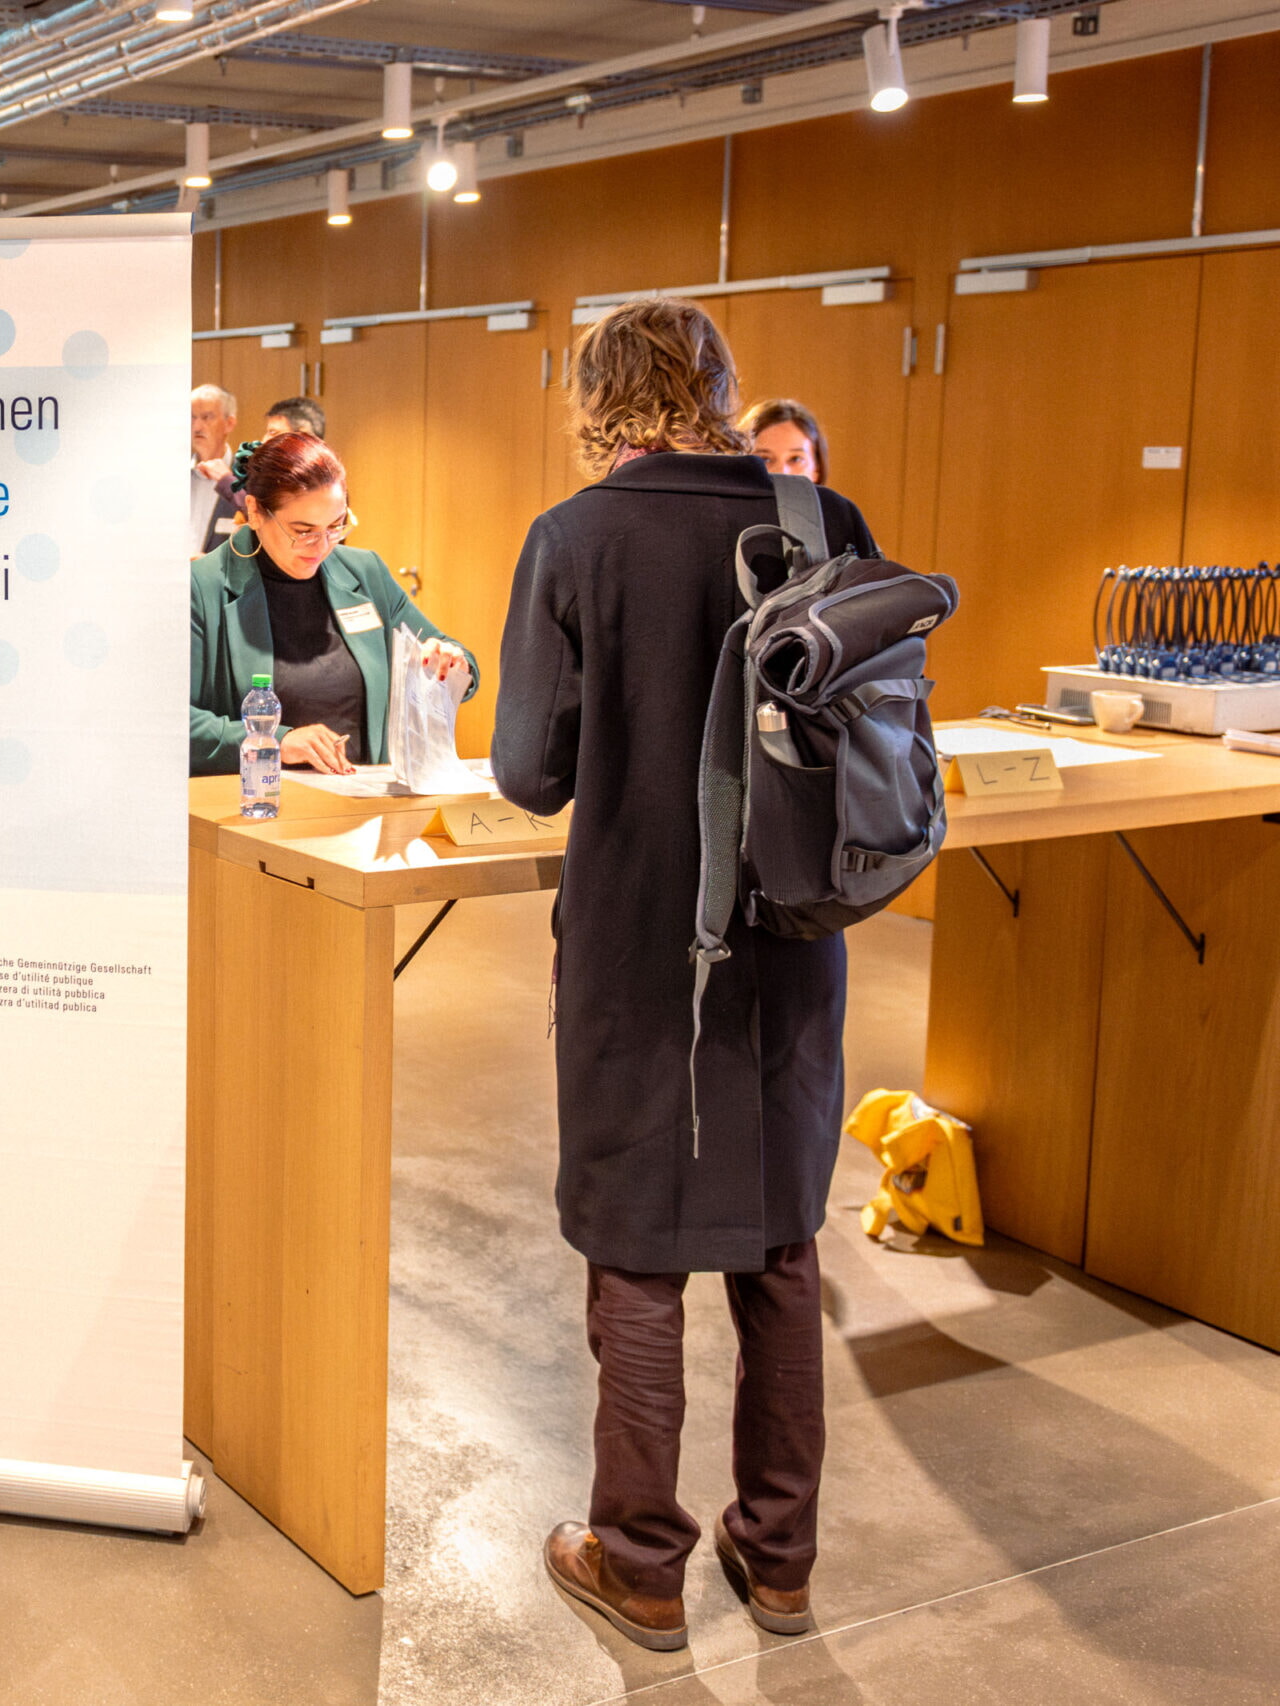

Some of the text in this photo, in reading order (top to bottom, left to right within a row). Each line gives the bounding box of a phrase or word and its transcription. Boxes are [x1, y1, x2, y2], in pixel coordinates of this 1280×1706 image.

[17, 958, 87, 973] Gemeinnützige
[90, 962, 152, 974] Gesellschaft
[53, 975, 94, 986] publique
[21, 985, 30, 995] di
[32, 986, 61, 997] utilità
[64, 988, 105, 1000] pubblica
[62, 1002, 97, 1013] publica
